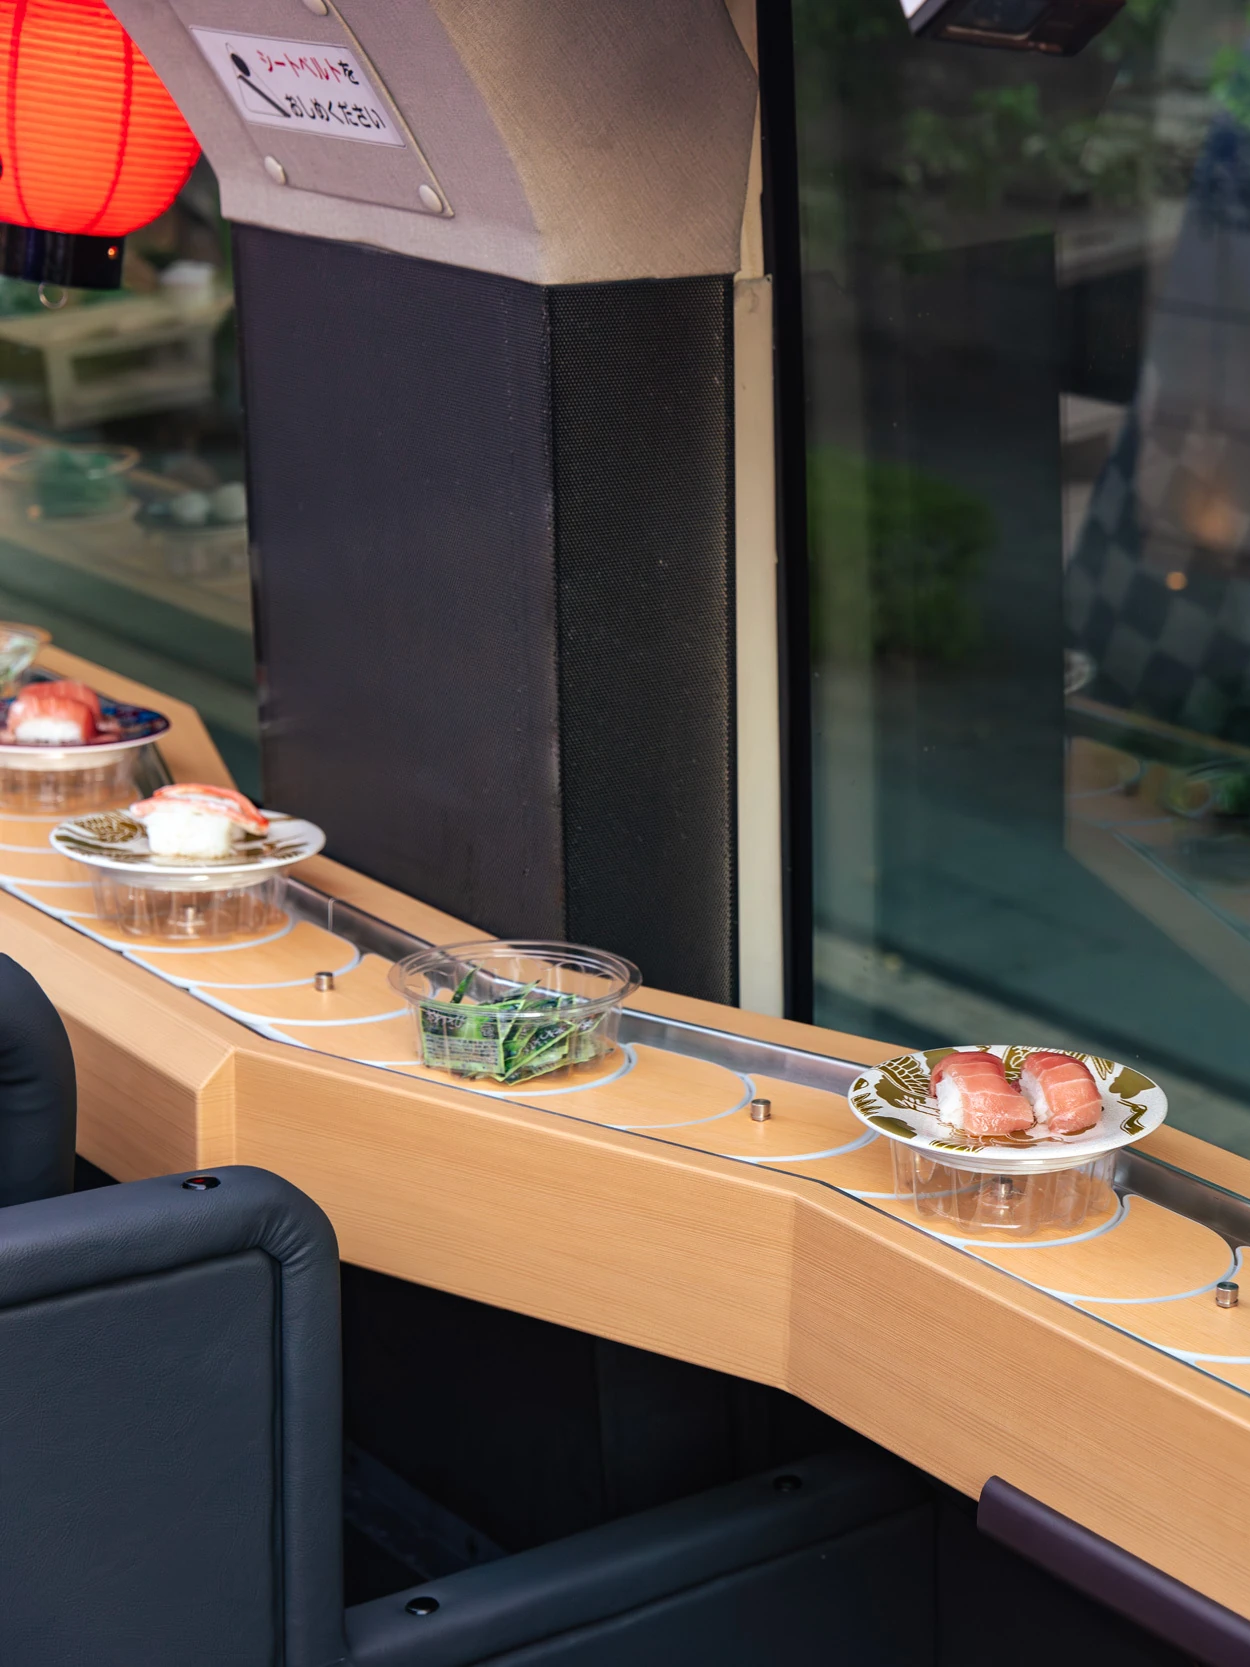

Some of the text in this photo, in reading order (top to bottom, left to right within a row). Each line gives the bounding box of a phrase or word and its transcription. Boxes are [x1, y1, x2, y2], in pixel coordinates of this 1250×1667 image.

[256, 50, 359, 85] シートベルトを
[285, 94, 386, 130] おしめください
